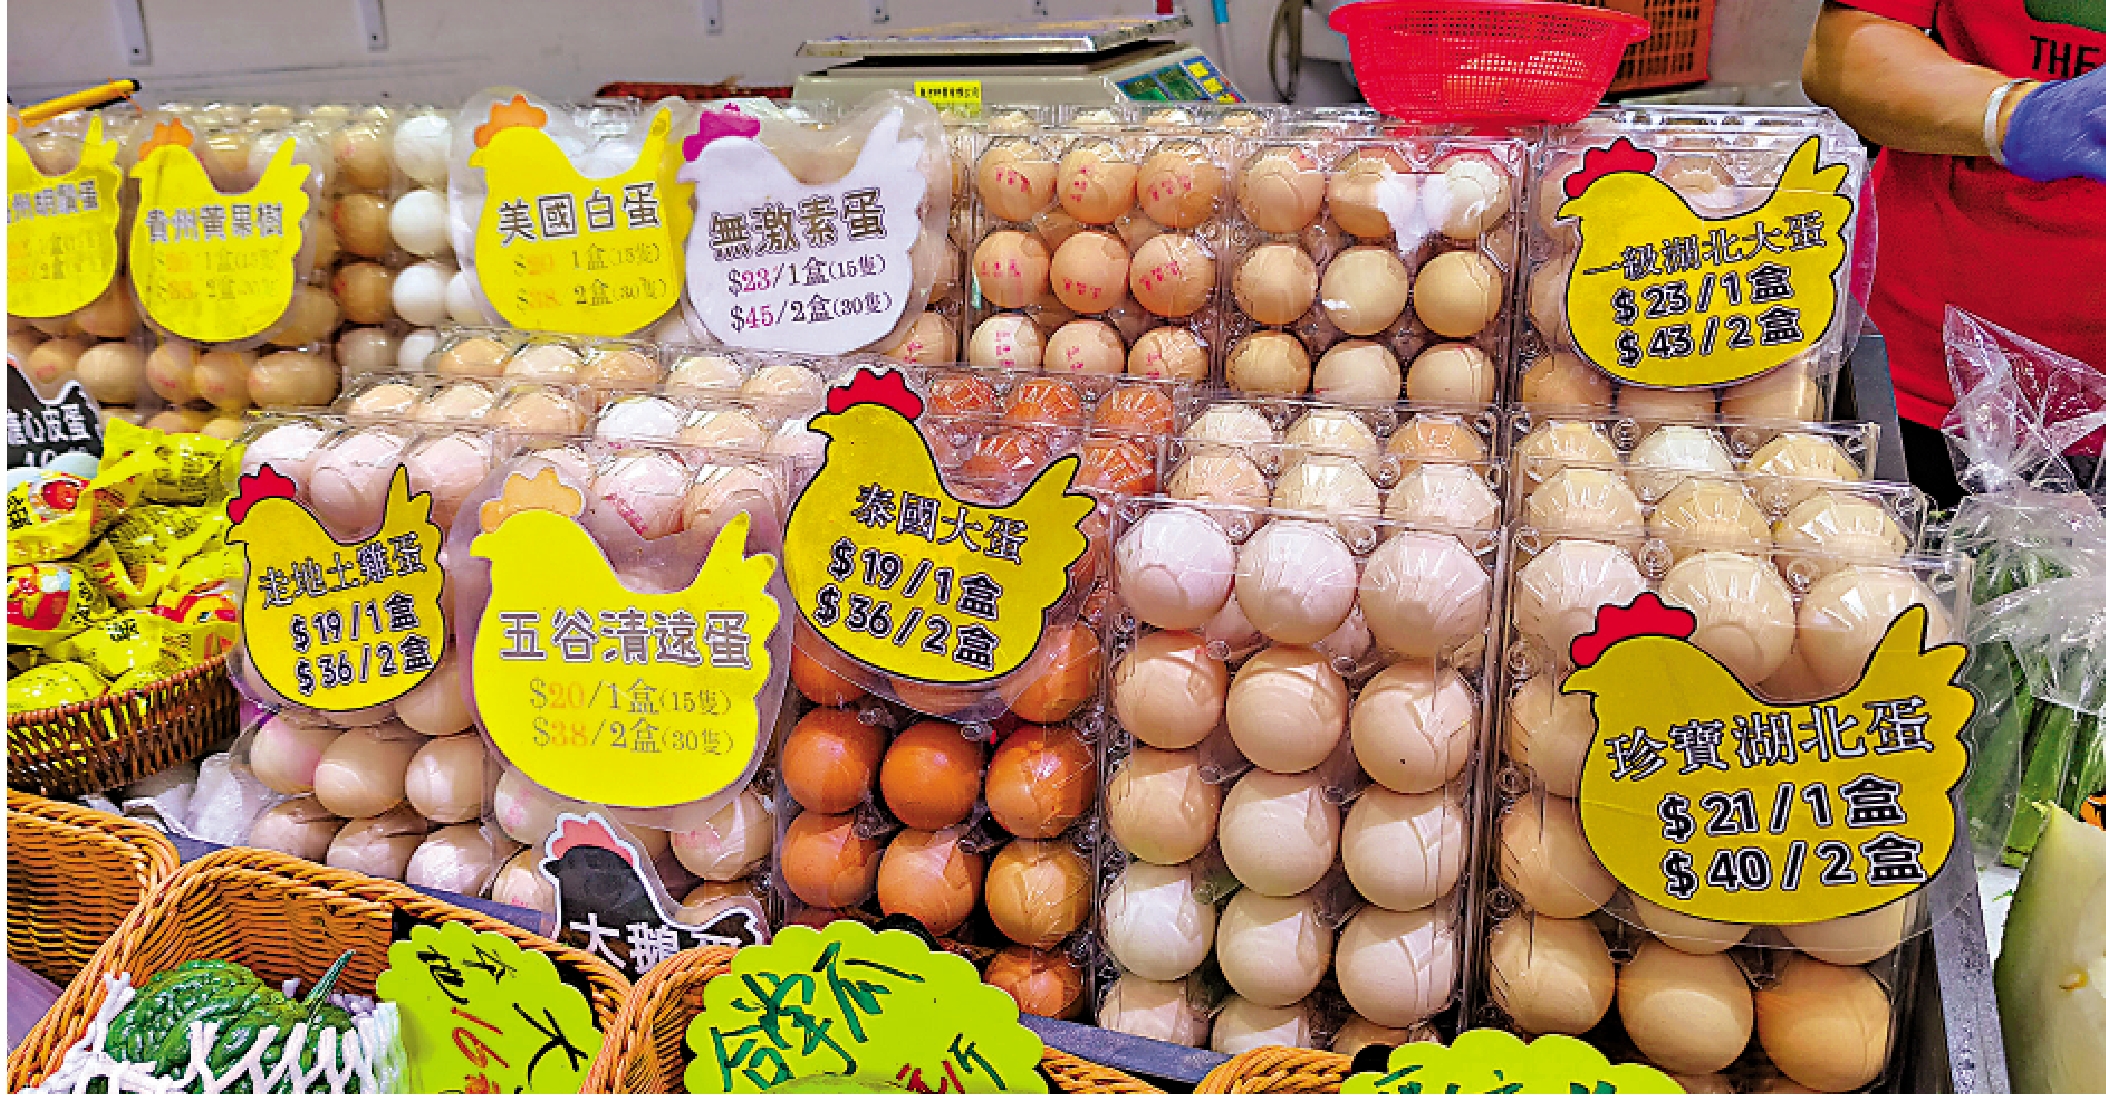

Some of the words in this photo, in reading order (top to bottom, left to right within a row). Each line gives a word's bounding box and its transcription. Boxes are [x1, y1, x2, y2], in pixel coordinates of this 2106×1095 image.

[2030, 36, 2100, 78] THE
[497, 181, 662, 248] 美國白蛋
[709, 187, 888, 261] 無激素蛋
[1582, 210, 1828, 281] 一級湖北大蛋
[850, 482, 1029, 566] 泰國大蛋
[258, 531, 427, 610] 走地土雞蛋
[498, 605, 752, 670] 五谷清遠蛋
[1603, 696, 1935, 782] 珍寶湖北蛋
[569, 912, 743, 975] 大鵝
